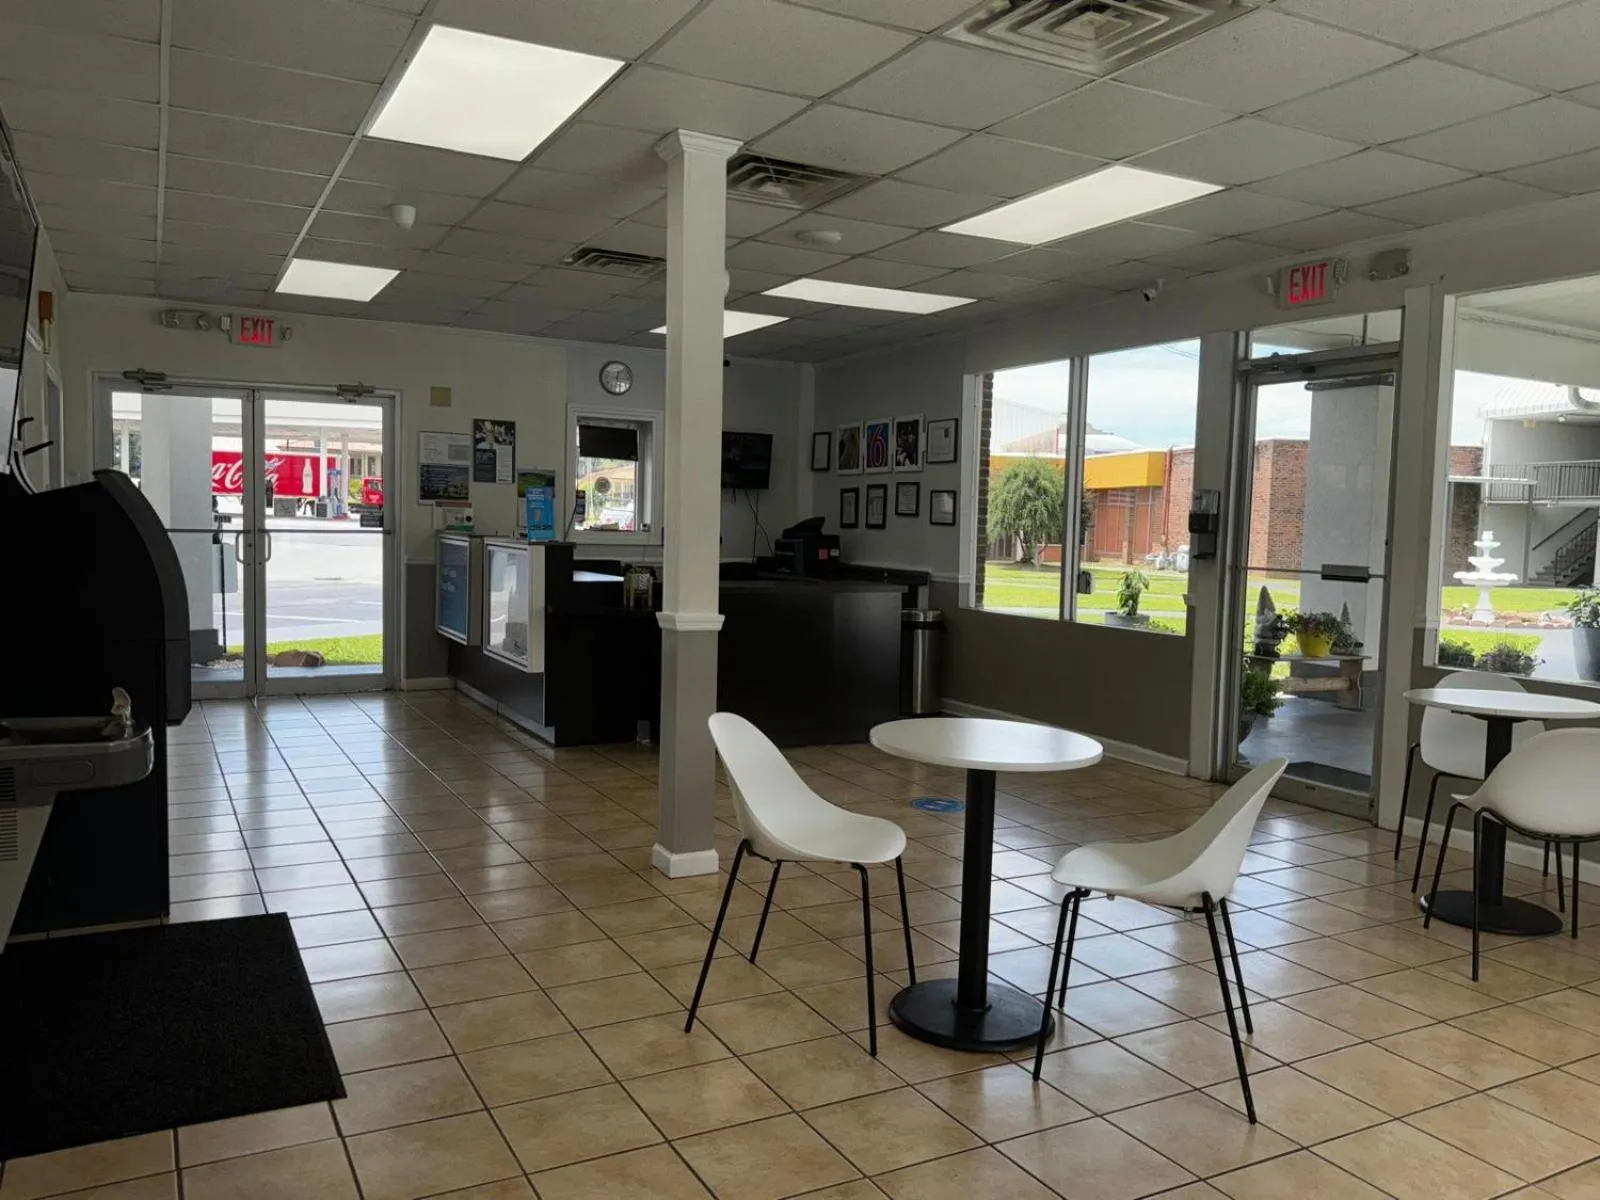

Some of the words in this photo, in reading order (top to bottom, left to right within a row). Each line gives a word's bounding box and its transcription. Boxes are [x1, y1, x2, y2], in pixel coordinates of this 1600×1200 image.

[1289, 263, 1327, 303] EXIT
[240, 317, 274, 344] EXIT
[870, 425, 888, 467] 6
